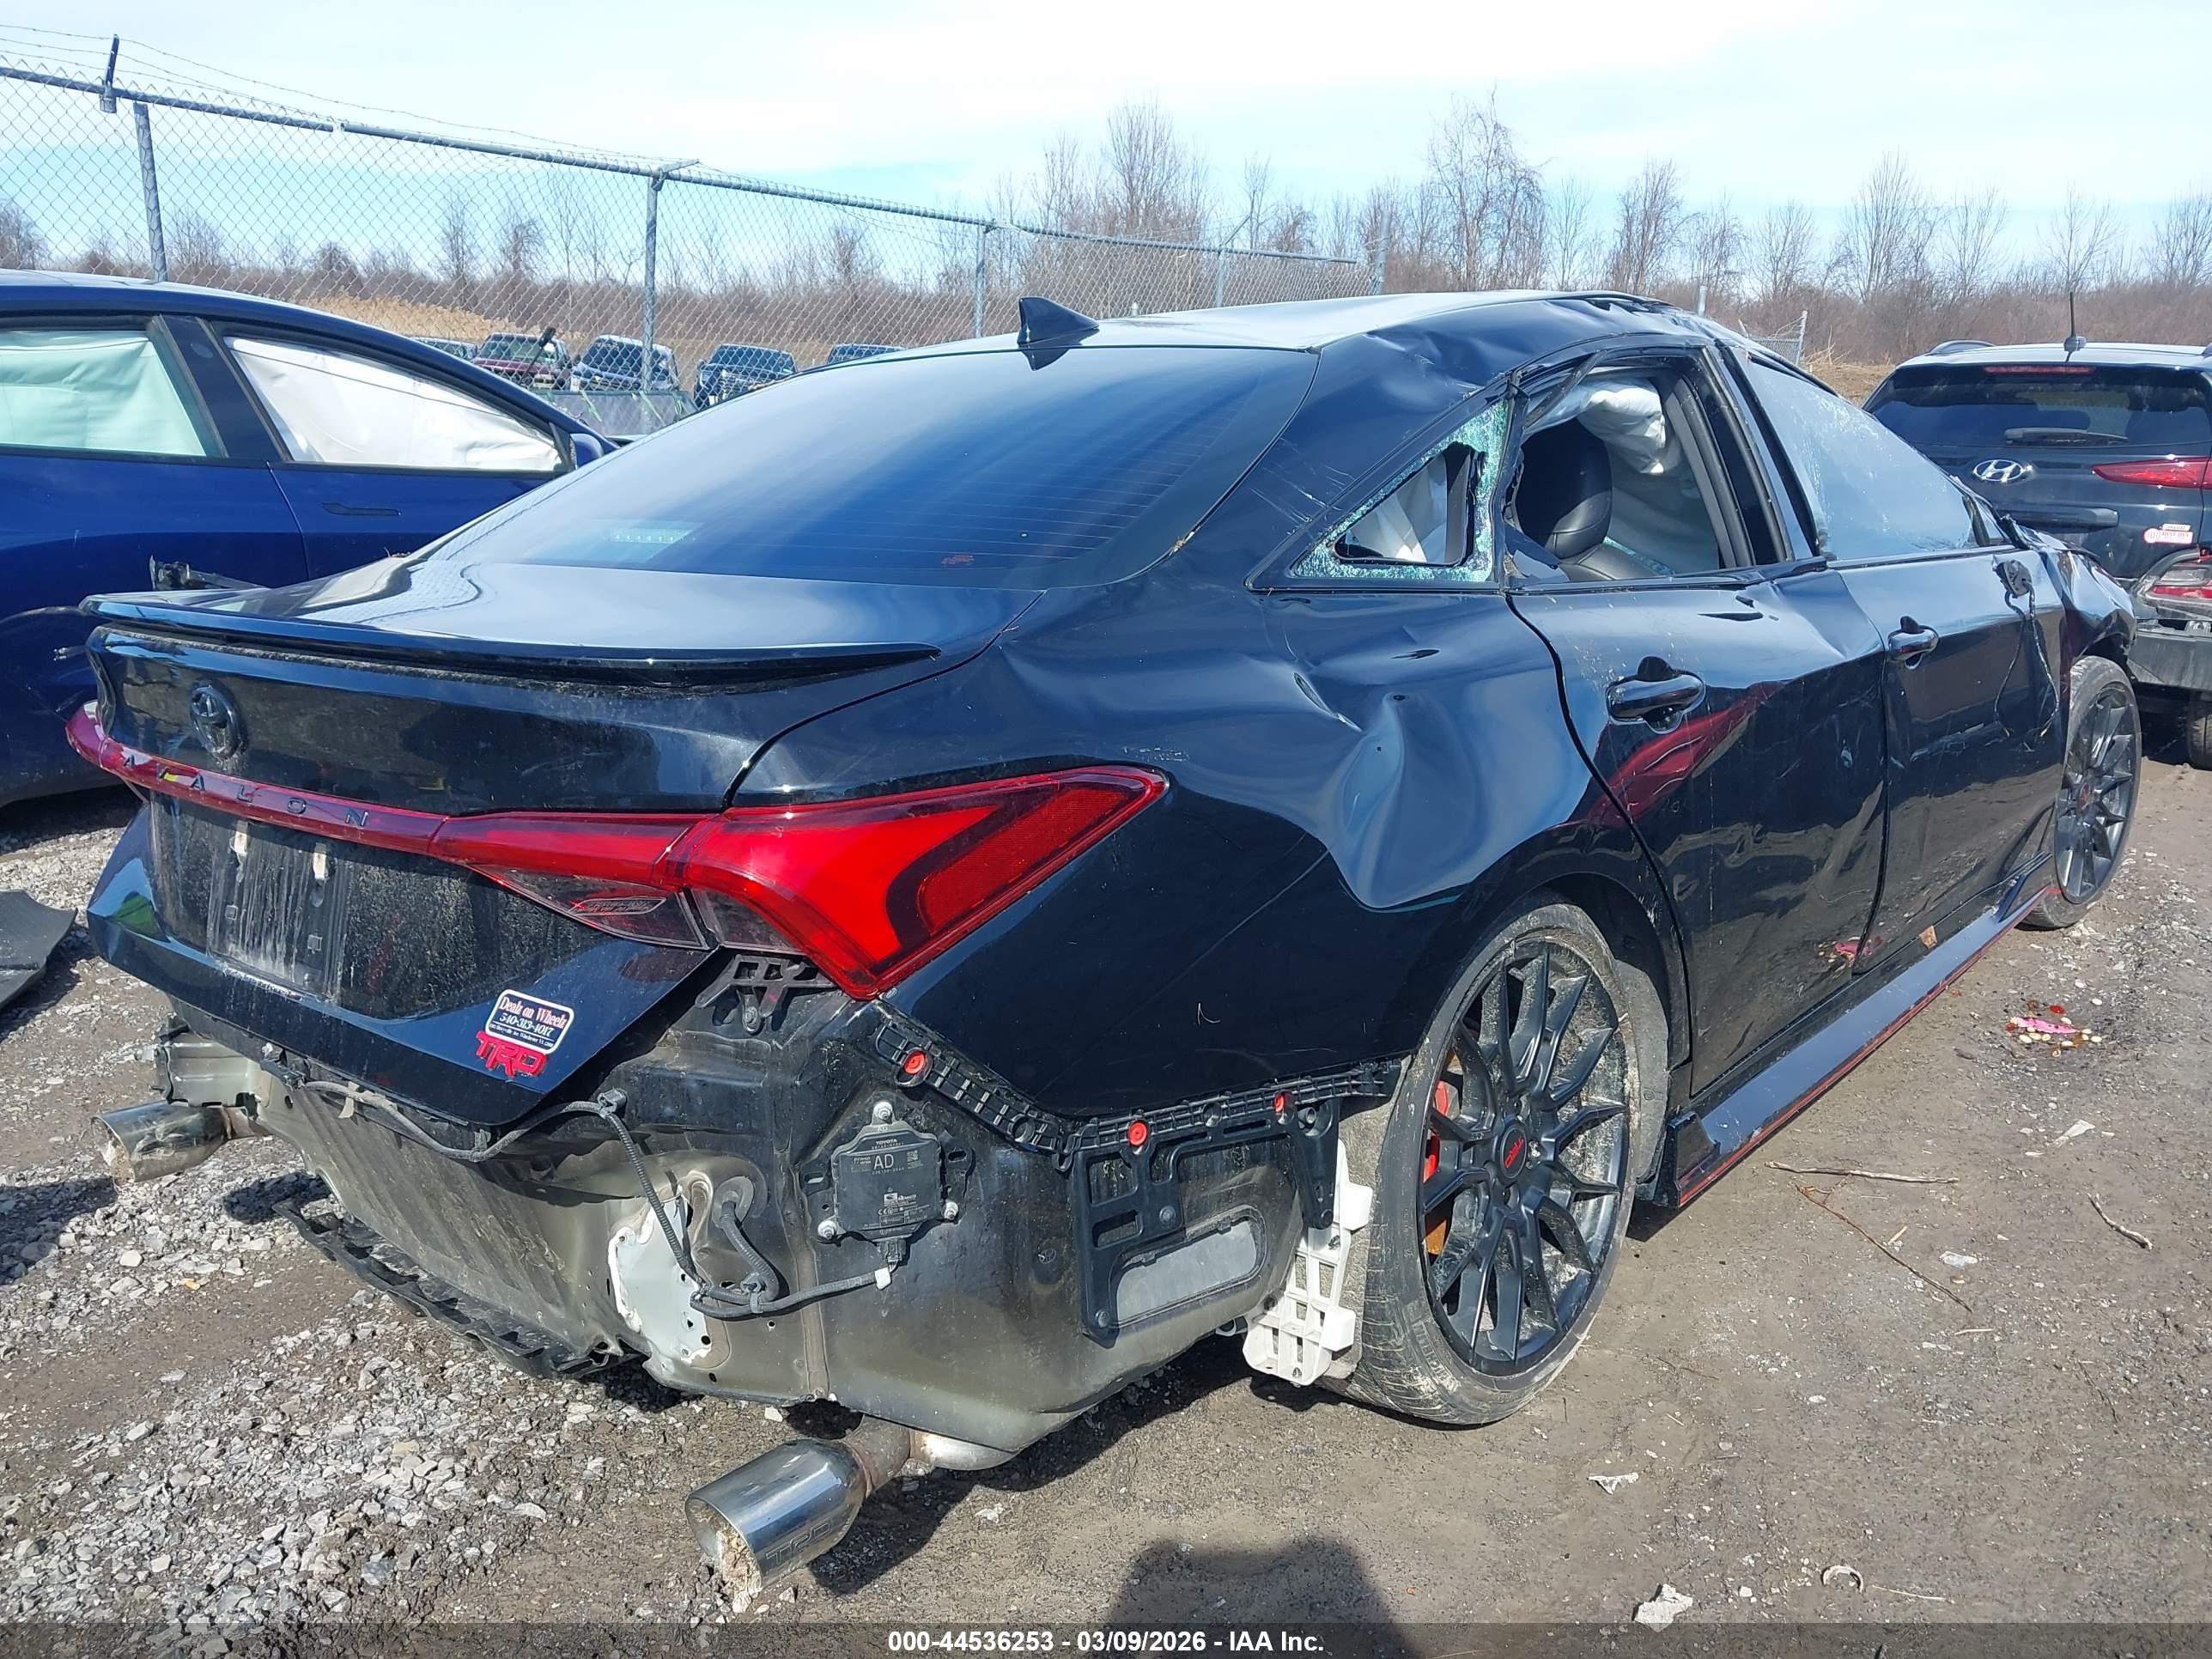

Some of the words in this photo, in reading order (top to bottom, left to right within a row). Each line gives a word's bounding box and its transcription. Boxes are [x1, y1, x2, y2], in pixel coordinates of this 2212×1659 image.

[124, 755, 368, 827] AVALON
[499, 996, 523, 1016] Dealz
[522, 1006, 535, 1019] on
[535, 1006, 568, 1029] Wheelz
[499, 1012, 555, 1037] 540-313-4017
[476, 1030, 546, 1077] TRD
[873, 1153, 894, 1170] AD
